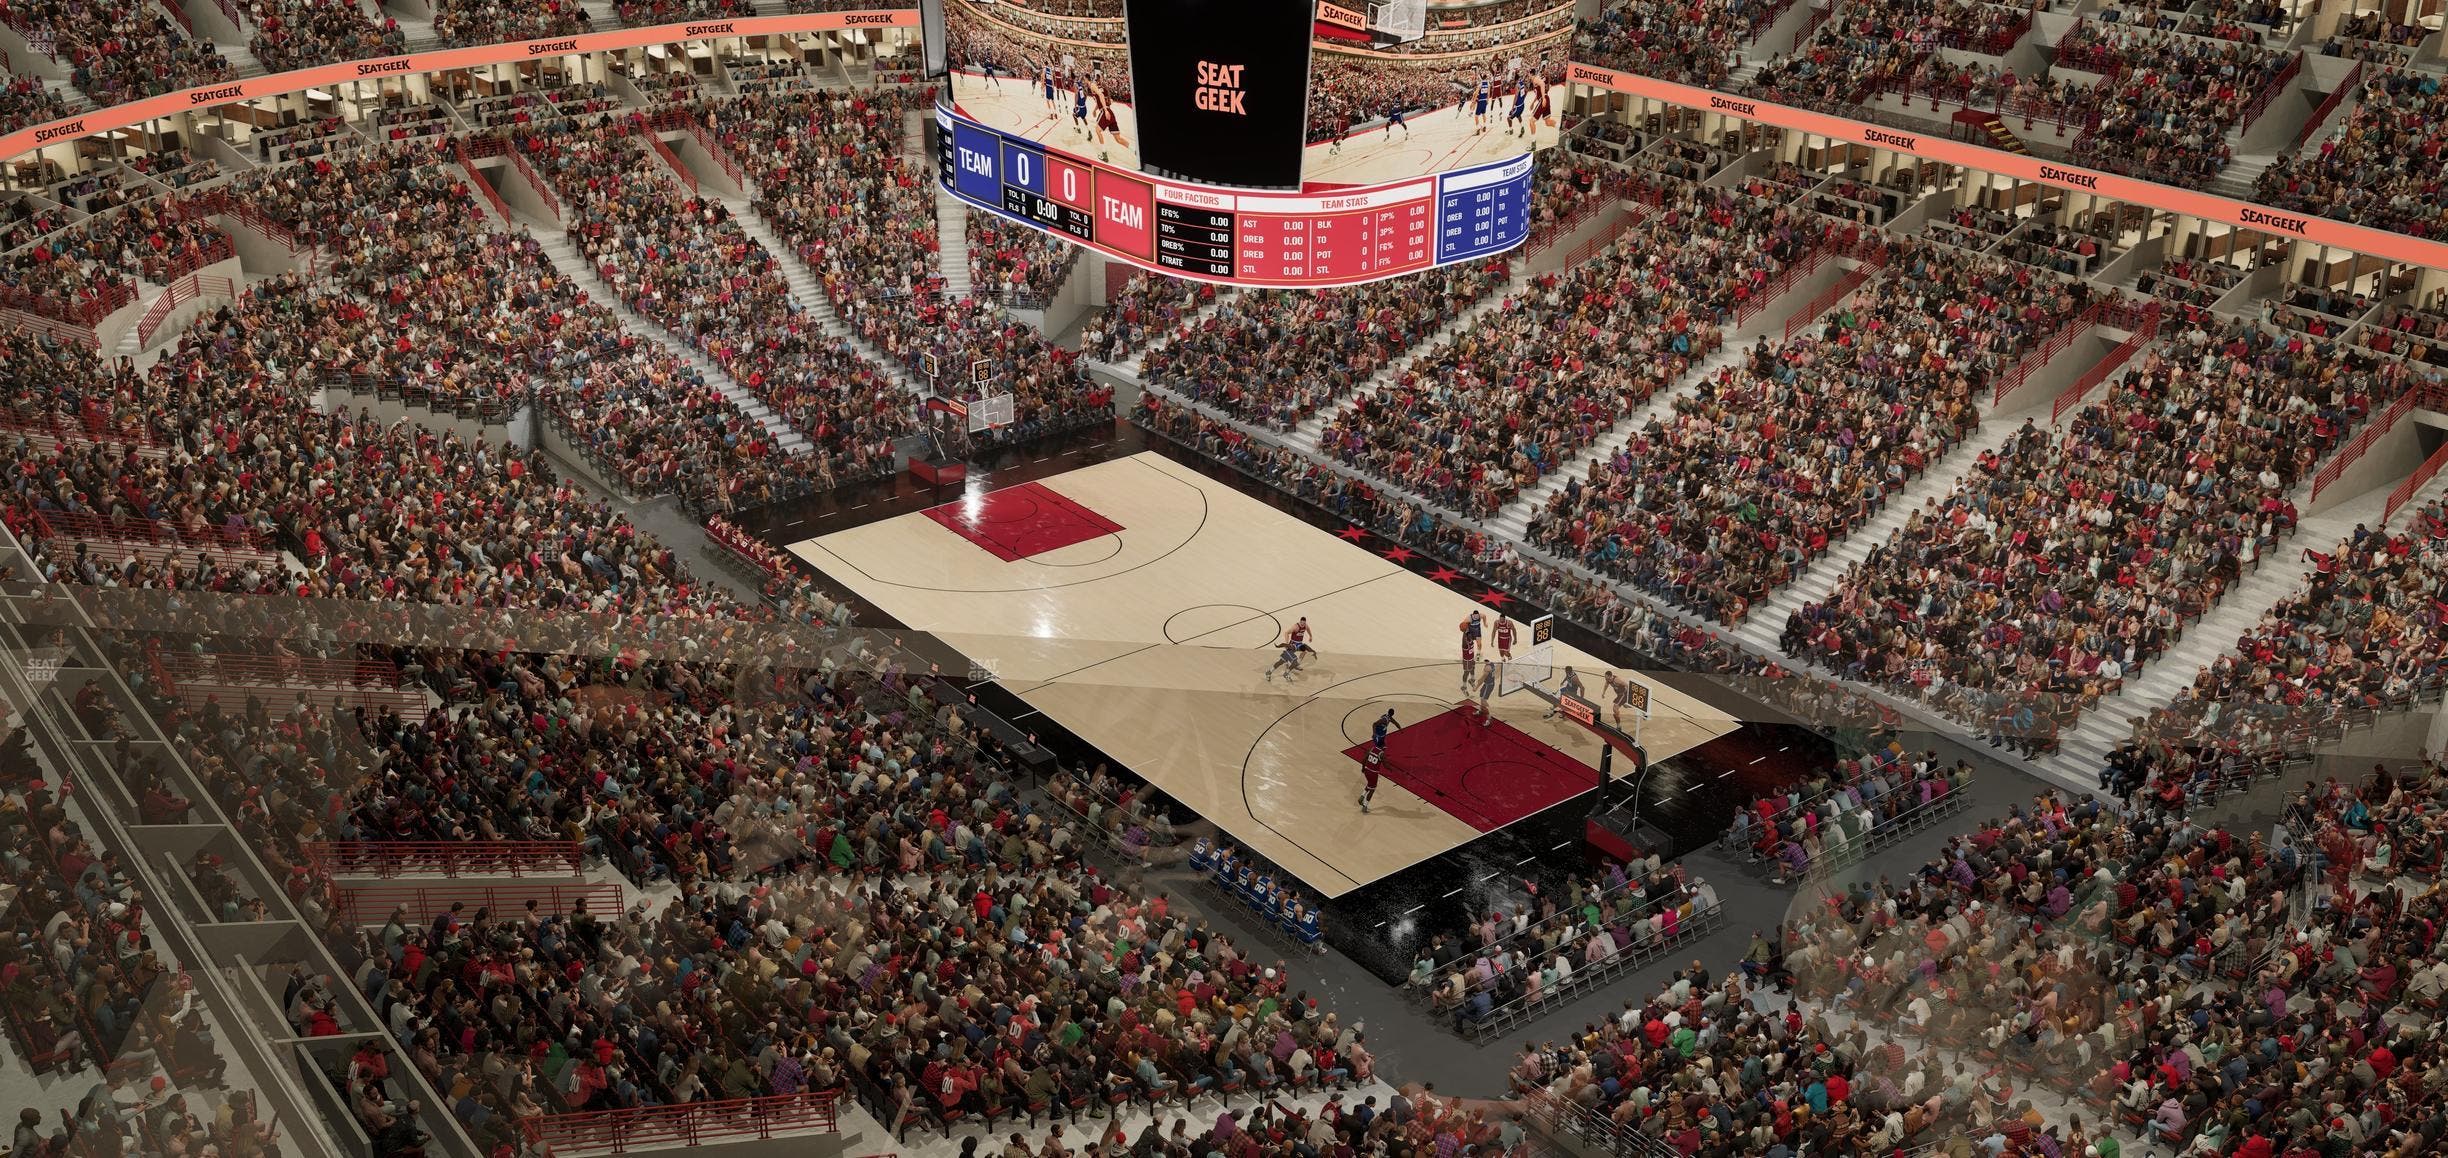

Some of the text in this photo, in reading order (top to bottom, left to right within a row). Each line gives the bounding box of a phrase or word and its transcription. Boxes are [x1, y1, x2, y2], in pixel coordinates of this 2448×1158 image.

[1323, 5, 1363, 27] SEATGEEK
[686, 23, 733, 36] SEATGEEK
[529, 39, 578, 54] SEATGEEK
[358, 60, 411, 76] SEATGEEK
[1197, 60, 1245, 88] SEAT
[1574, 67, 1613, 86] SEATGEEK
[191, 85, 243, 104] SEATGEEK
[1194, 86, 1247, 115] GEEK
[1710, 96, 1755, 116] SEATGEEK
[35, 120, 85, 142] SEATGEEK
[1865, 128, 1915, 151] SEATGEEK
[958, 147, 992, 178] TEAM
[1017, 152, 1030, 186] 0
[1502, 166, 1516, 177] TEAM
[2040, 166, 2097, 190] SEATGEEK
[1063, 168, 1076, 201] 0
[1008, 189, 1026, 202] TOL 0
[1164, 188, 1220, 206] FOUR FACTORS
[1320, 196, 1369, 209] TEAM STATS
[1447, 192, 1491, 208] AST 0.00
[1008, 202, 1026, 215] FLS 0
[1036, 199, 1058, 220] 0:00
[1103, 195, 1143, 230] TEAM
[1409, 205, 1425, 216] 0.00
[1475, 206, 1490, 217] 0.00
[1069, 211, 1088, 225] TOL 0
[1161, 207, 1229, 227] EFG% 0.00
[1317, 216, 1368, 229] BLK 0
[2240, 208, 2307, 235] SEATGEEK
[1070, 224, 1089, 238] FLS 0
[1243, 220, 1304, 231] AST 0.00
[1409, 220, 1425, 231] 0.00
[1475, 221, 1490, 232] 0.00
[1210, 232, 1229, 243] 0.00
[1283, 236, 1303, 246] 0.00
[1362, 231, 1368, 241] 0
[1409, 235, 1424, 246] 0.00
[1496, 231, 1506, 240] STL
[1446, 235, 1489, 252] STL 0.00
[1210, 248, 1229, 259] 0.00
[1283, 251, 1303, 261] 0.00
[1316, 246, 1367, 260] POT 0
[1408, 250, 1423, 261] 0.00
[1161, 255, 1229, 274] FTRATE 0.00
[1243, 265, 1303, 276] STL 0.00
[1316, 261, 1367, 274] STL 0
[1536, 629, 1549, 642] 88
[1632, 693, 1644, 708] 88
[1254, 883, 1266, 895] 00
[1009, 1021, 1022, 1039] 00
[941, 1076, 954, 1095] 00
